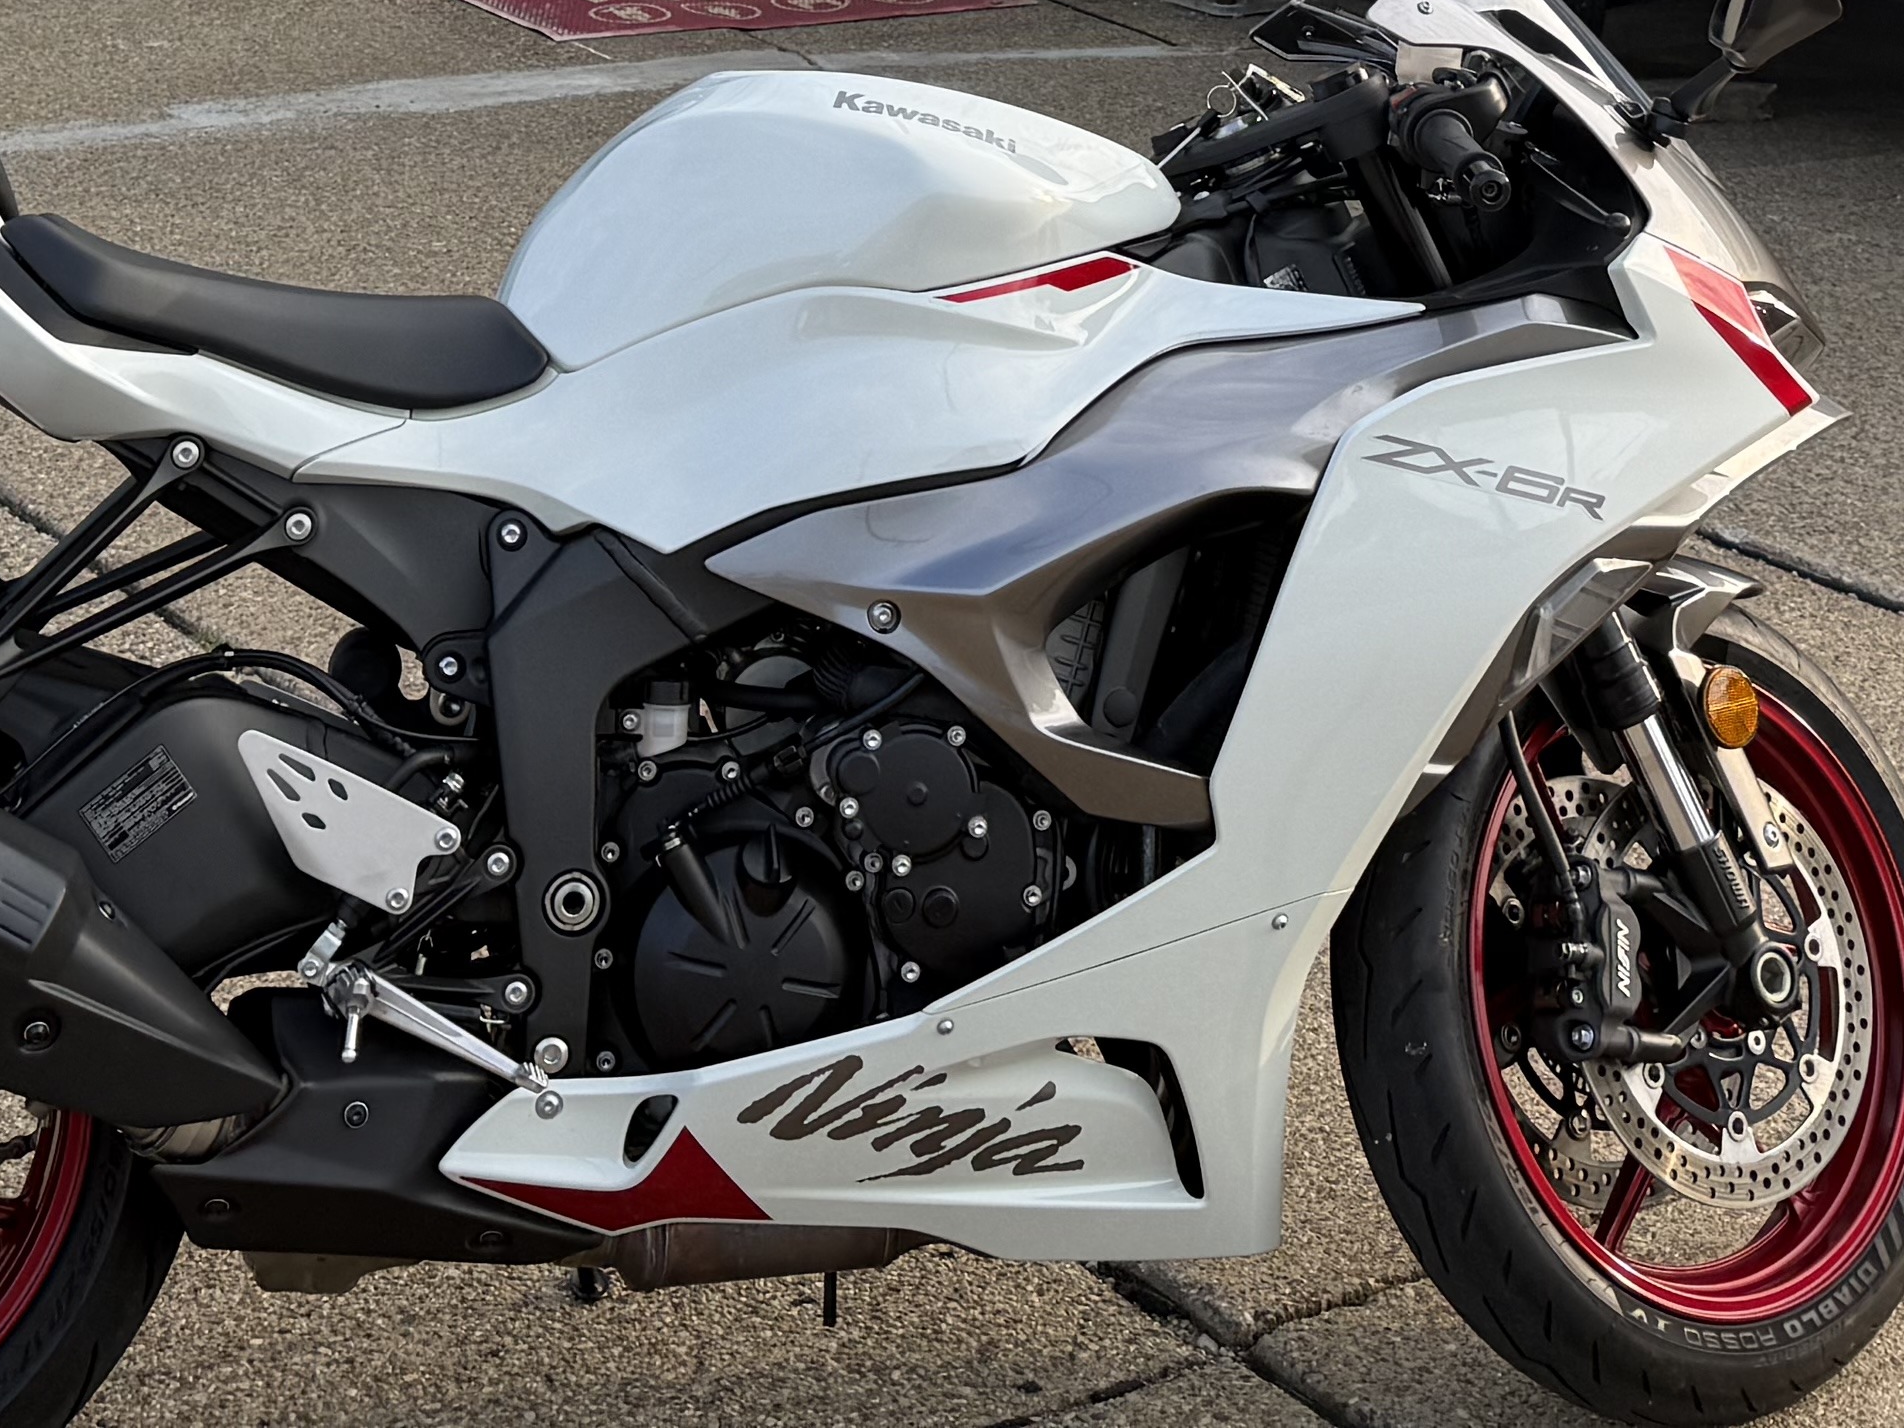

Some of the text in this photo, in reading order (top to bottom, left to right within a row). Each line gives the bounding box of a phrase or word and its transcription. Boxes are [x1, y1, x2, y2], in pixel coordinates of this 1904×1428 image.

[832, 90, 1016, 154] Kawasaki
[1361, 435, 1606, 521] ZX-6R
[1712, 847, 1750, 909] SHOWA
[737, 1054, 1085, 1183] Ninja
[1783, 1262, 1880, 1338] DIABLO
[1684, 1327, 1777, 1351] ROSSO
